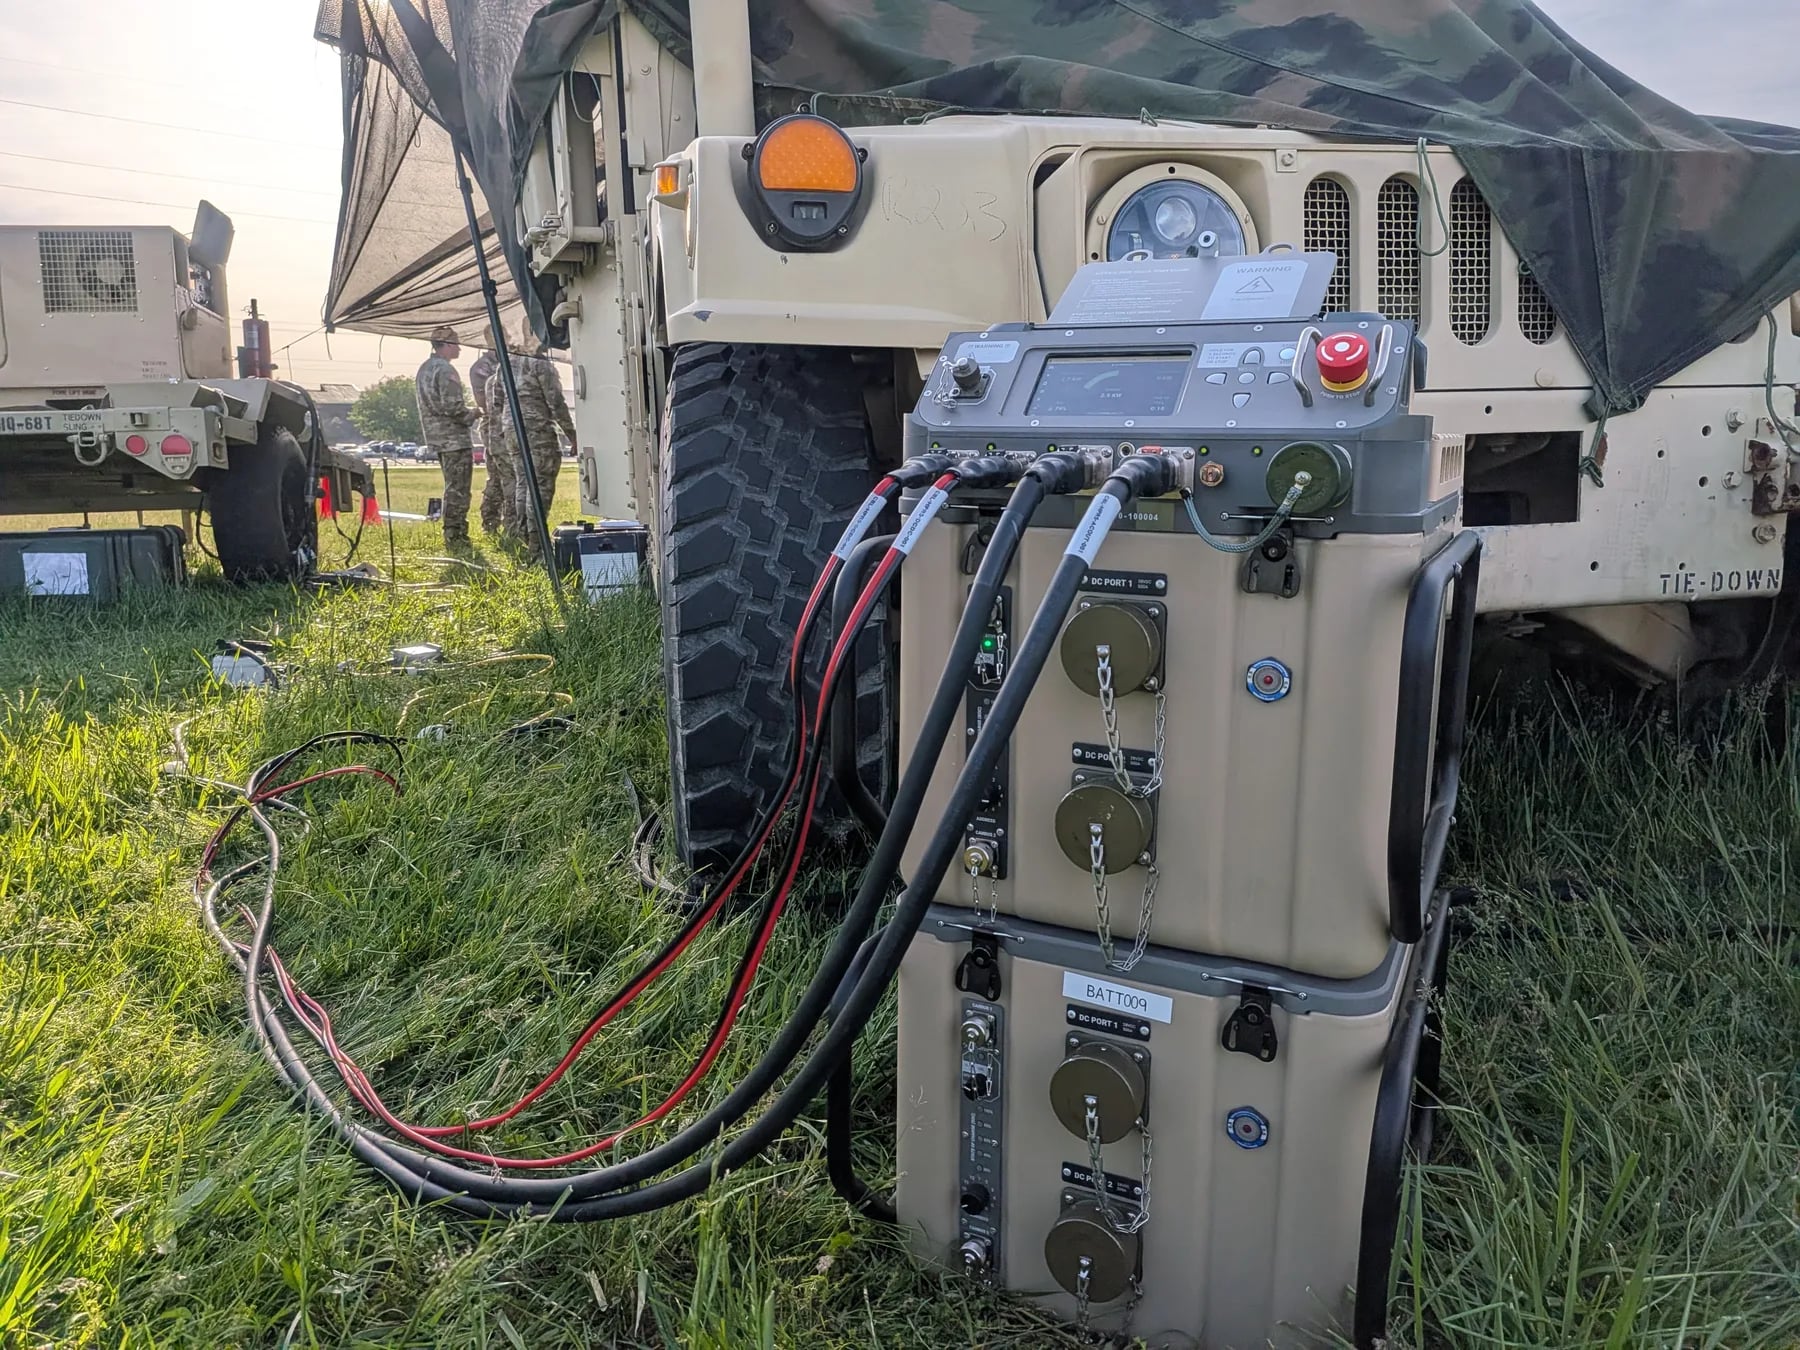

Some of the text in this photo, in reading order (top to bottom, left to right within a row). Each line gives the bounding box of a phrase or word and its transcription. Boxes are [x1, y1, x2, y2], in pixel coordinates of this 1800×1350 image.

[1236, 265, 1292, 274] WARNING
[63, 413, 102, 421] TIEDOWN
[63, 423, 88, 431] SLING
[1091, 577, 1133, 588] DC PORT 1
[1660, 569, 1780, 594] TIE-DOWN
[1085, 751, 1096, 759] DC
[1086, 984, 1148, 1012] BATT009
[1079, 1014, 1118, 1029] DC PORT 1
[1074, 1172, 1085, 1181] DC
